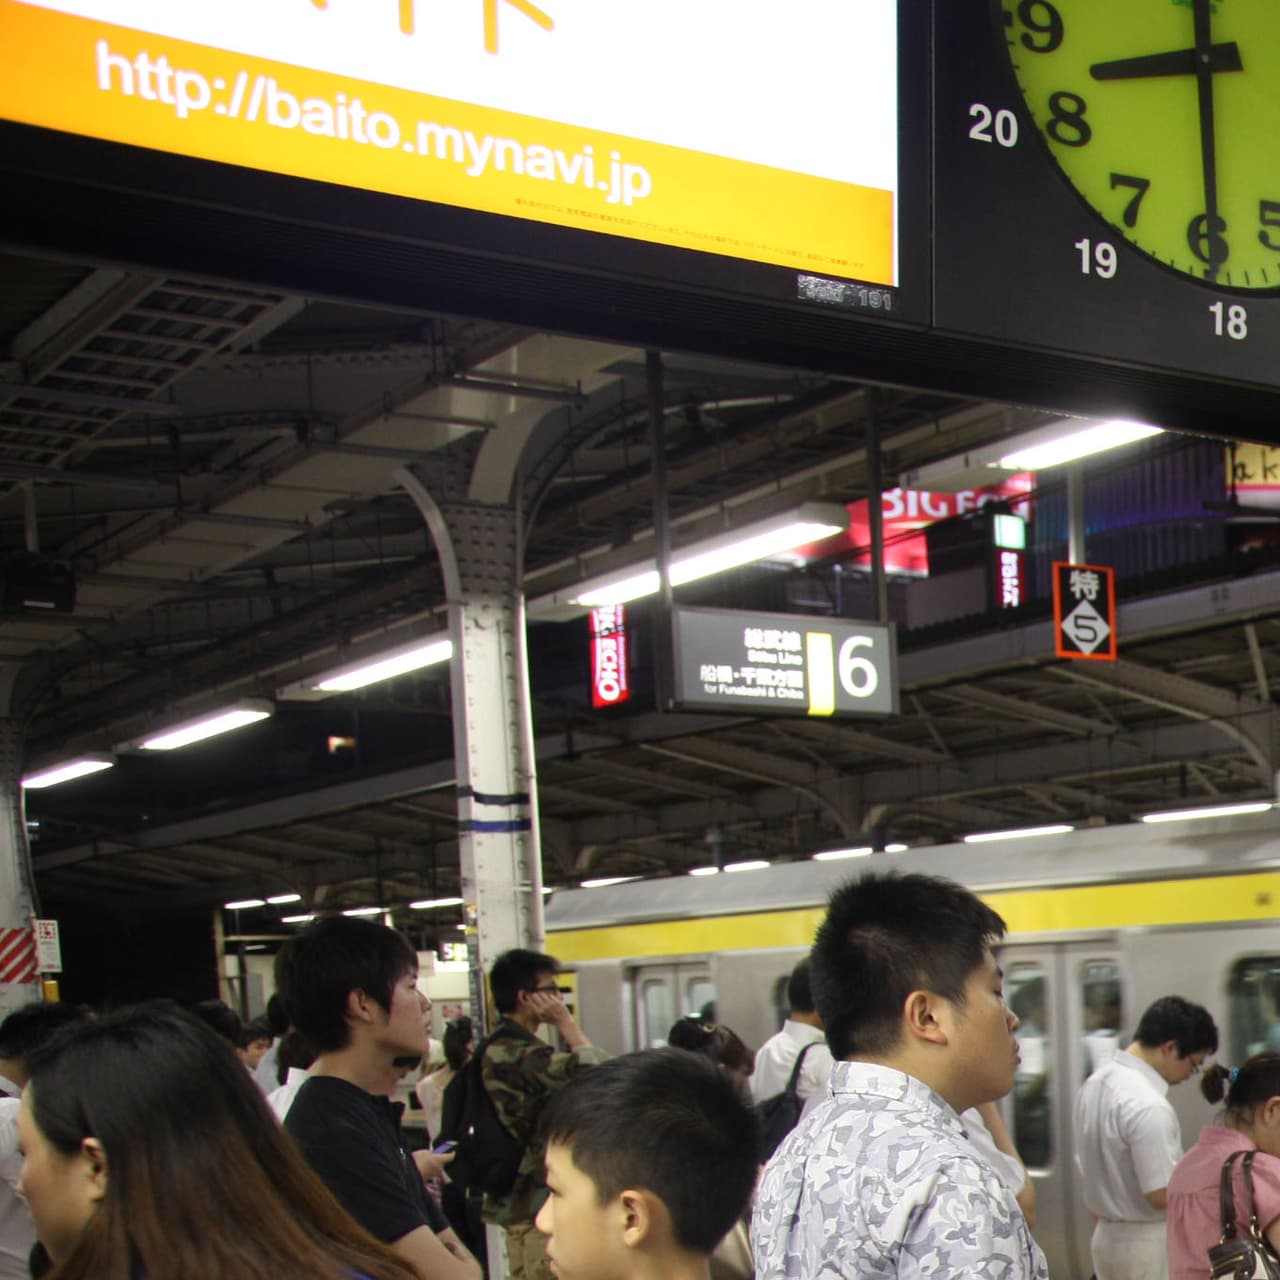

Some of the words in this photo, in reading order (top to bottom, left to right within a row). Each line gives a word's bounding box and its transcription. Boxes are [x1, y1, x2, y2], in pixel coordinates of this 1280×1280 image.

[1018, 0, 1064, 53] 9
[97, 38, 652, 207] http://baito.mynavi.jp
[968, 103, 1019, 148] 20
[1045, 91, 1092, 147] 8
[1109, 172, 1151, 228] 7
[1074, 238, 1117, 279] 19
[1186, 213, 1230, 264] 6
[1208, 302, 1248, 340] 18
[1073, 614, 1098, 643] 5
[838, 635, 878, 698] 6
